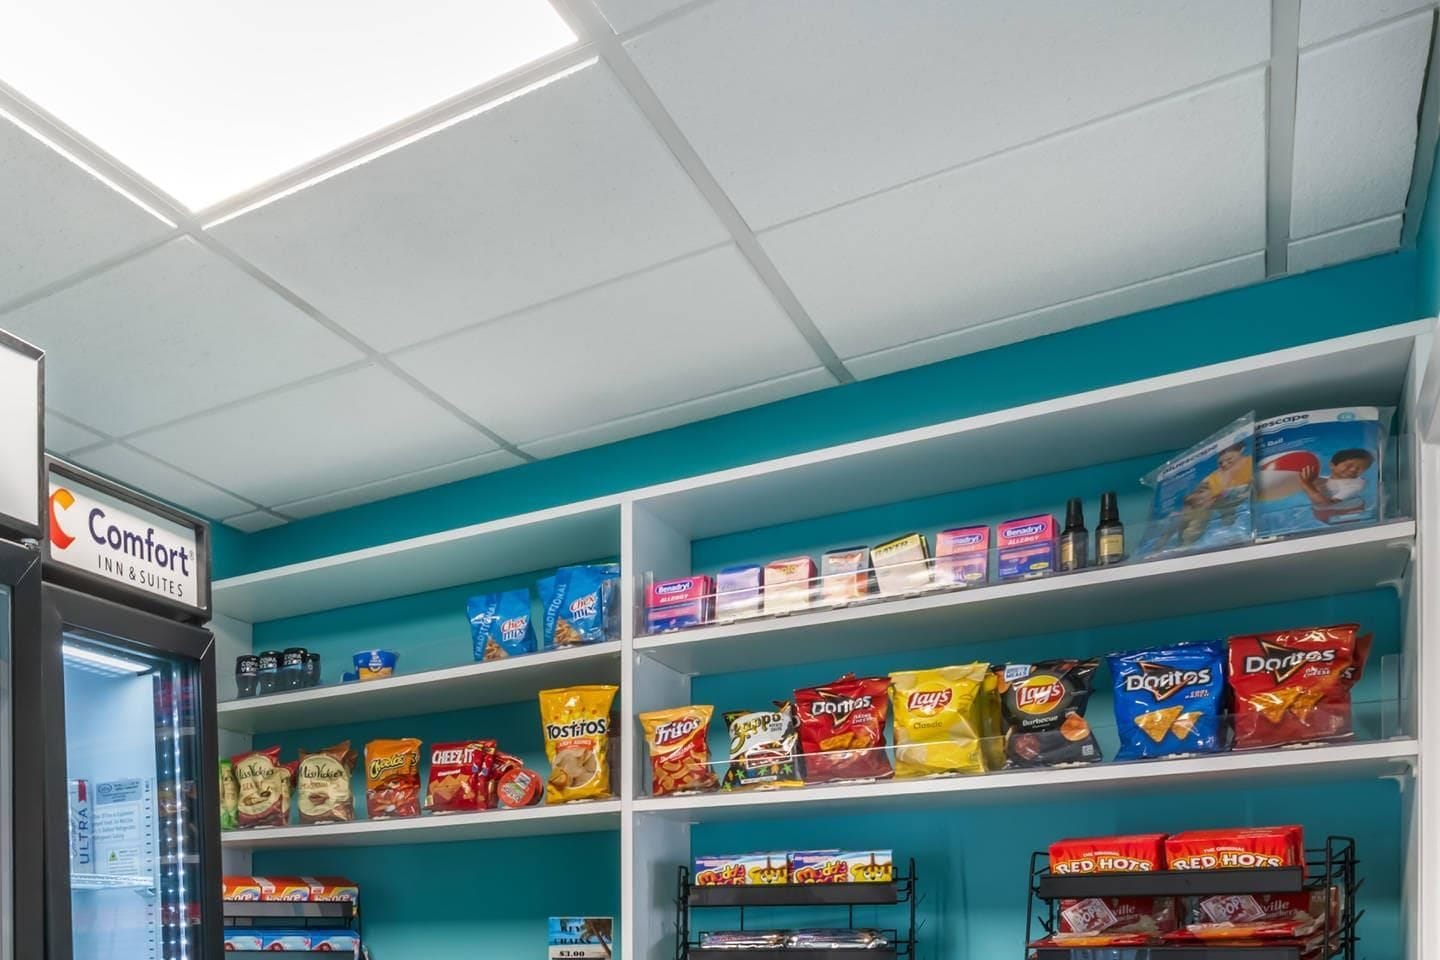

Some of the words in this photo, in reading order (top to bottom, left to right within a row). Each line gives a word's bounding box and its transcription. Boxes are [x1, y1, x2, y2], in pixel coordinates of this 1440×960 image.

[1007, 524, 1043, 537] Benadryl
[88, 507, 189, 577] Comfort
[1008, 535, 1039, 545] ALLERGY
[98, 554, 124, 577] INN
[128, 566, 137, 581] &
[140, 569, 183, 597] SUITES
[659, 582, 690, 593] Benadryl
[570, 593, 597, 611] Chex
[544, 583, 567, 640] TRADITIONAL
[502, 617, 526, 633] Chex
[1246, 649, 1336, 673] Doritos
[1126, 668, 1211, 691] Doritos
[812, 696, 872, 715] Doritos
[79, 808, 89, 864] ULTRA
[1056, 859, 1094, 873] RED
[1100, 857, 1151, 871] HOTS
[1174, 855, 1216, 868] RED
[1223, 853, 1281, 867] HOTS
[1110, 904, 1135, 916] ville
[1262, 900, 1290, 912] ville
